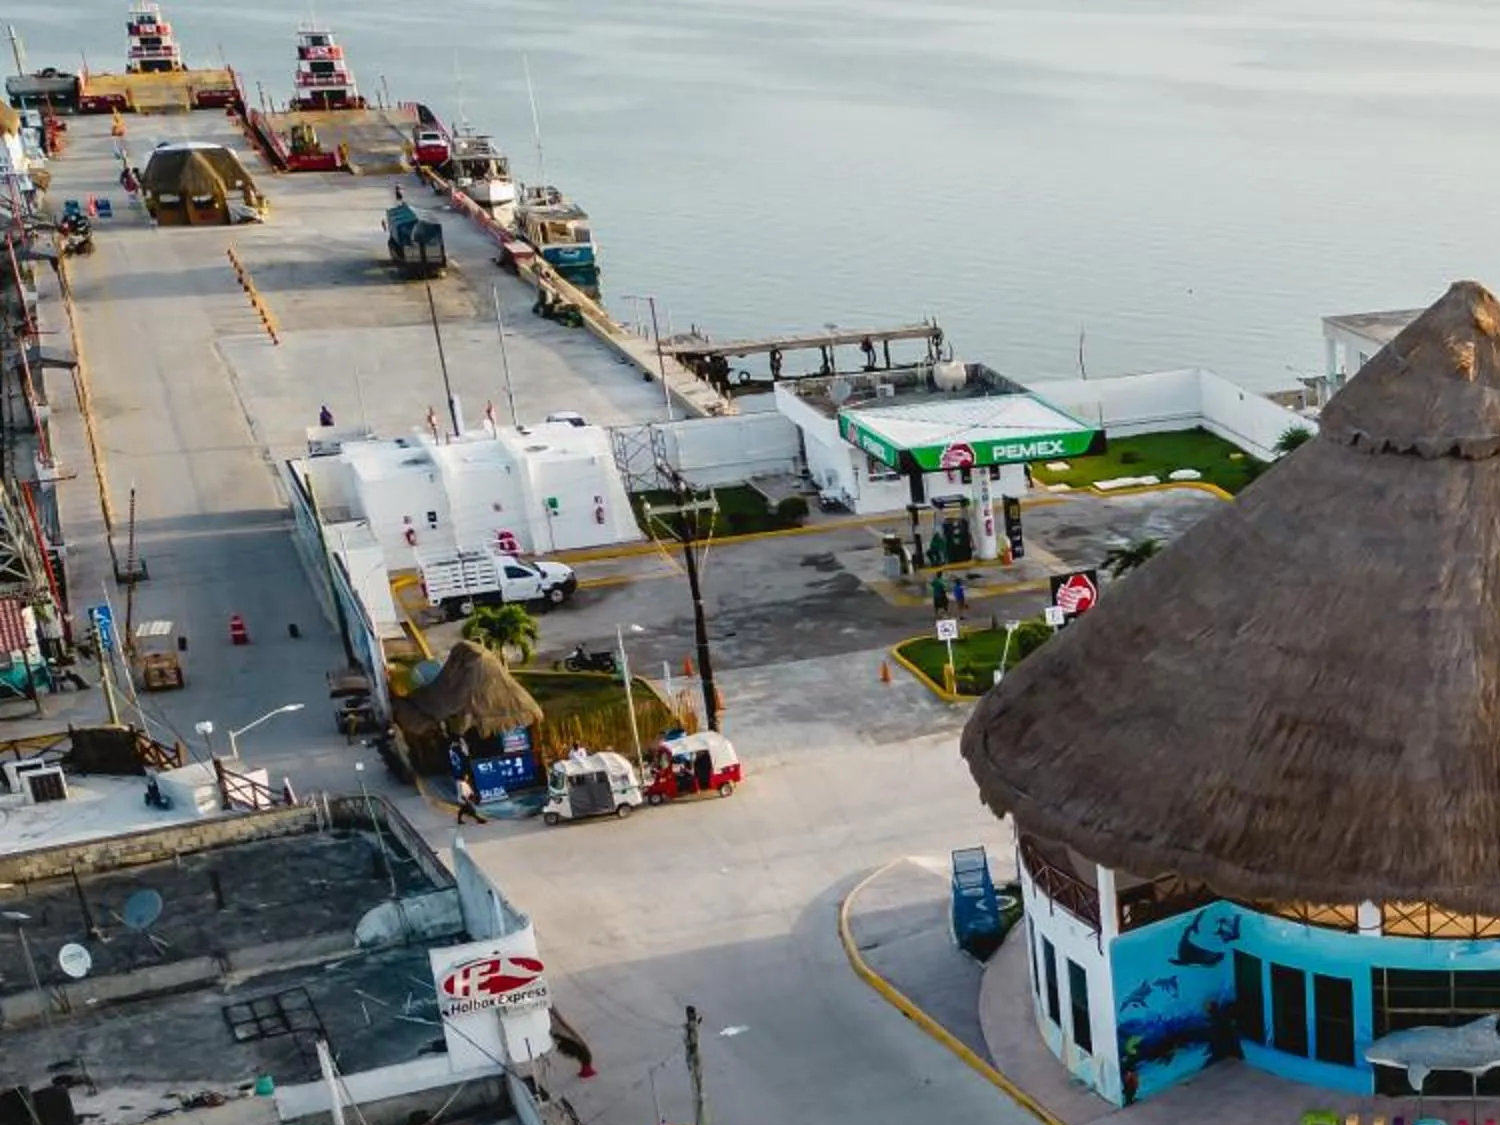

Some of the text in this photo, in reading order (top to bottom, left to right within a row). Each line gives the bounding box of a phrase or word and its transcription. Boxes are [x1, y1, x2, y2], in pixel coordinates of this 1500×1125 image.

[992, 439, 1064, 461] PEMEX
[451, 998, 495, 1015] Holbox
[499, 987, 547, 1004] Express
